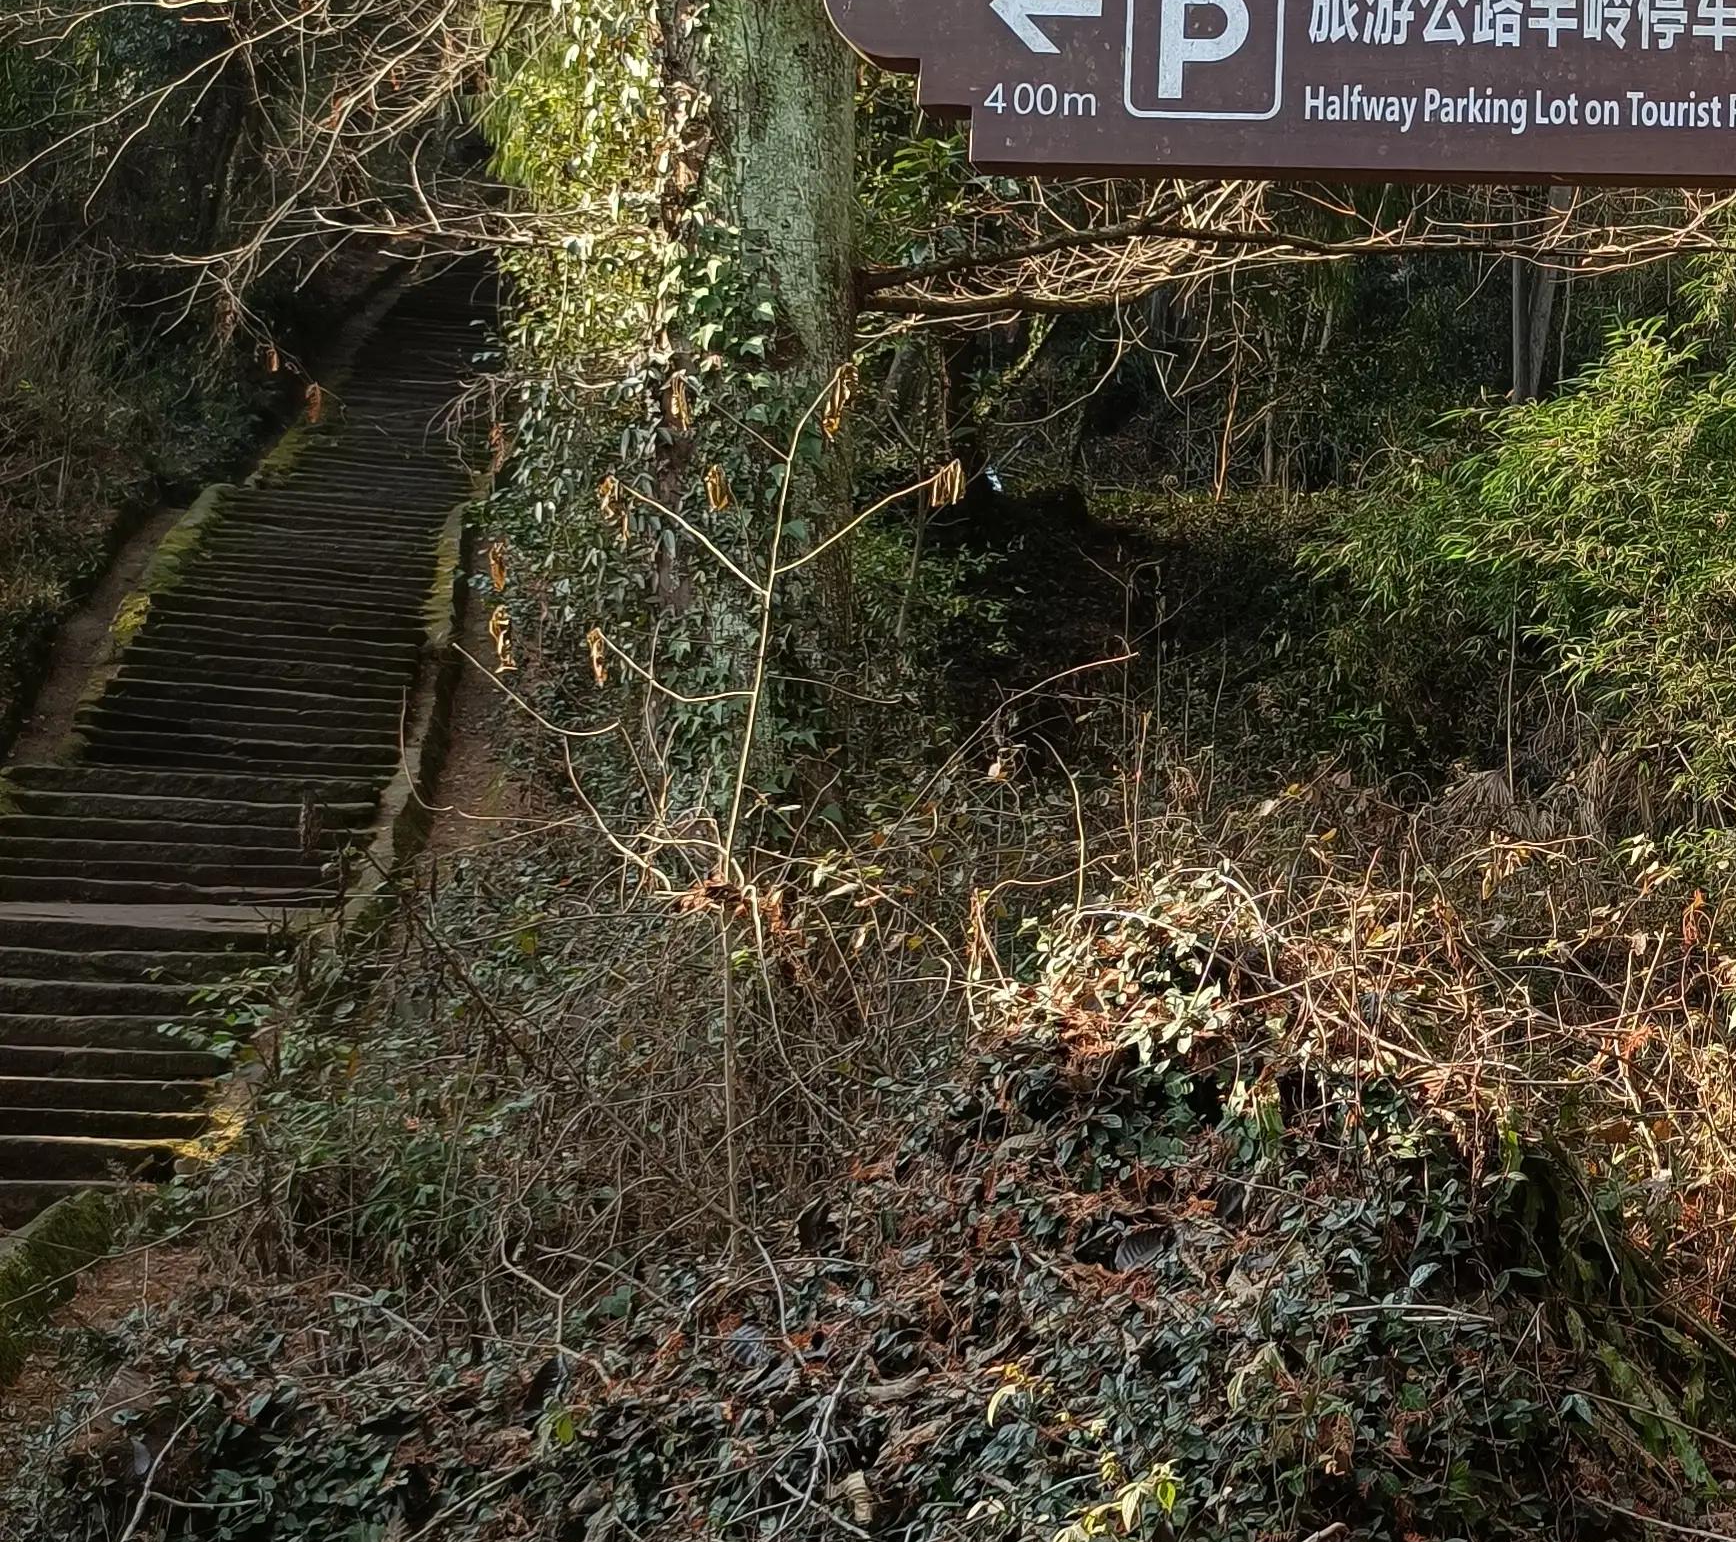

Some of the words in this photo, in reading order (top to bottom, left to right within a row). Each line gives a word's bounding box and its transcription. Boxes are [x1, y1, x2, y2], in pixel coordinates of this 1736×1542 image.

[982, 82, 1097, 118] 400m
[1303, 85, 1419, 134] Halfway
[1423, 87, 1528, 135] Parking
[1535, 89, 1580, 126] Lot
[1584, 100, 1620, 127] on
[1626, 90, 1722, 129] Tourist
